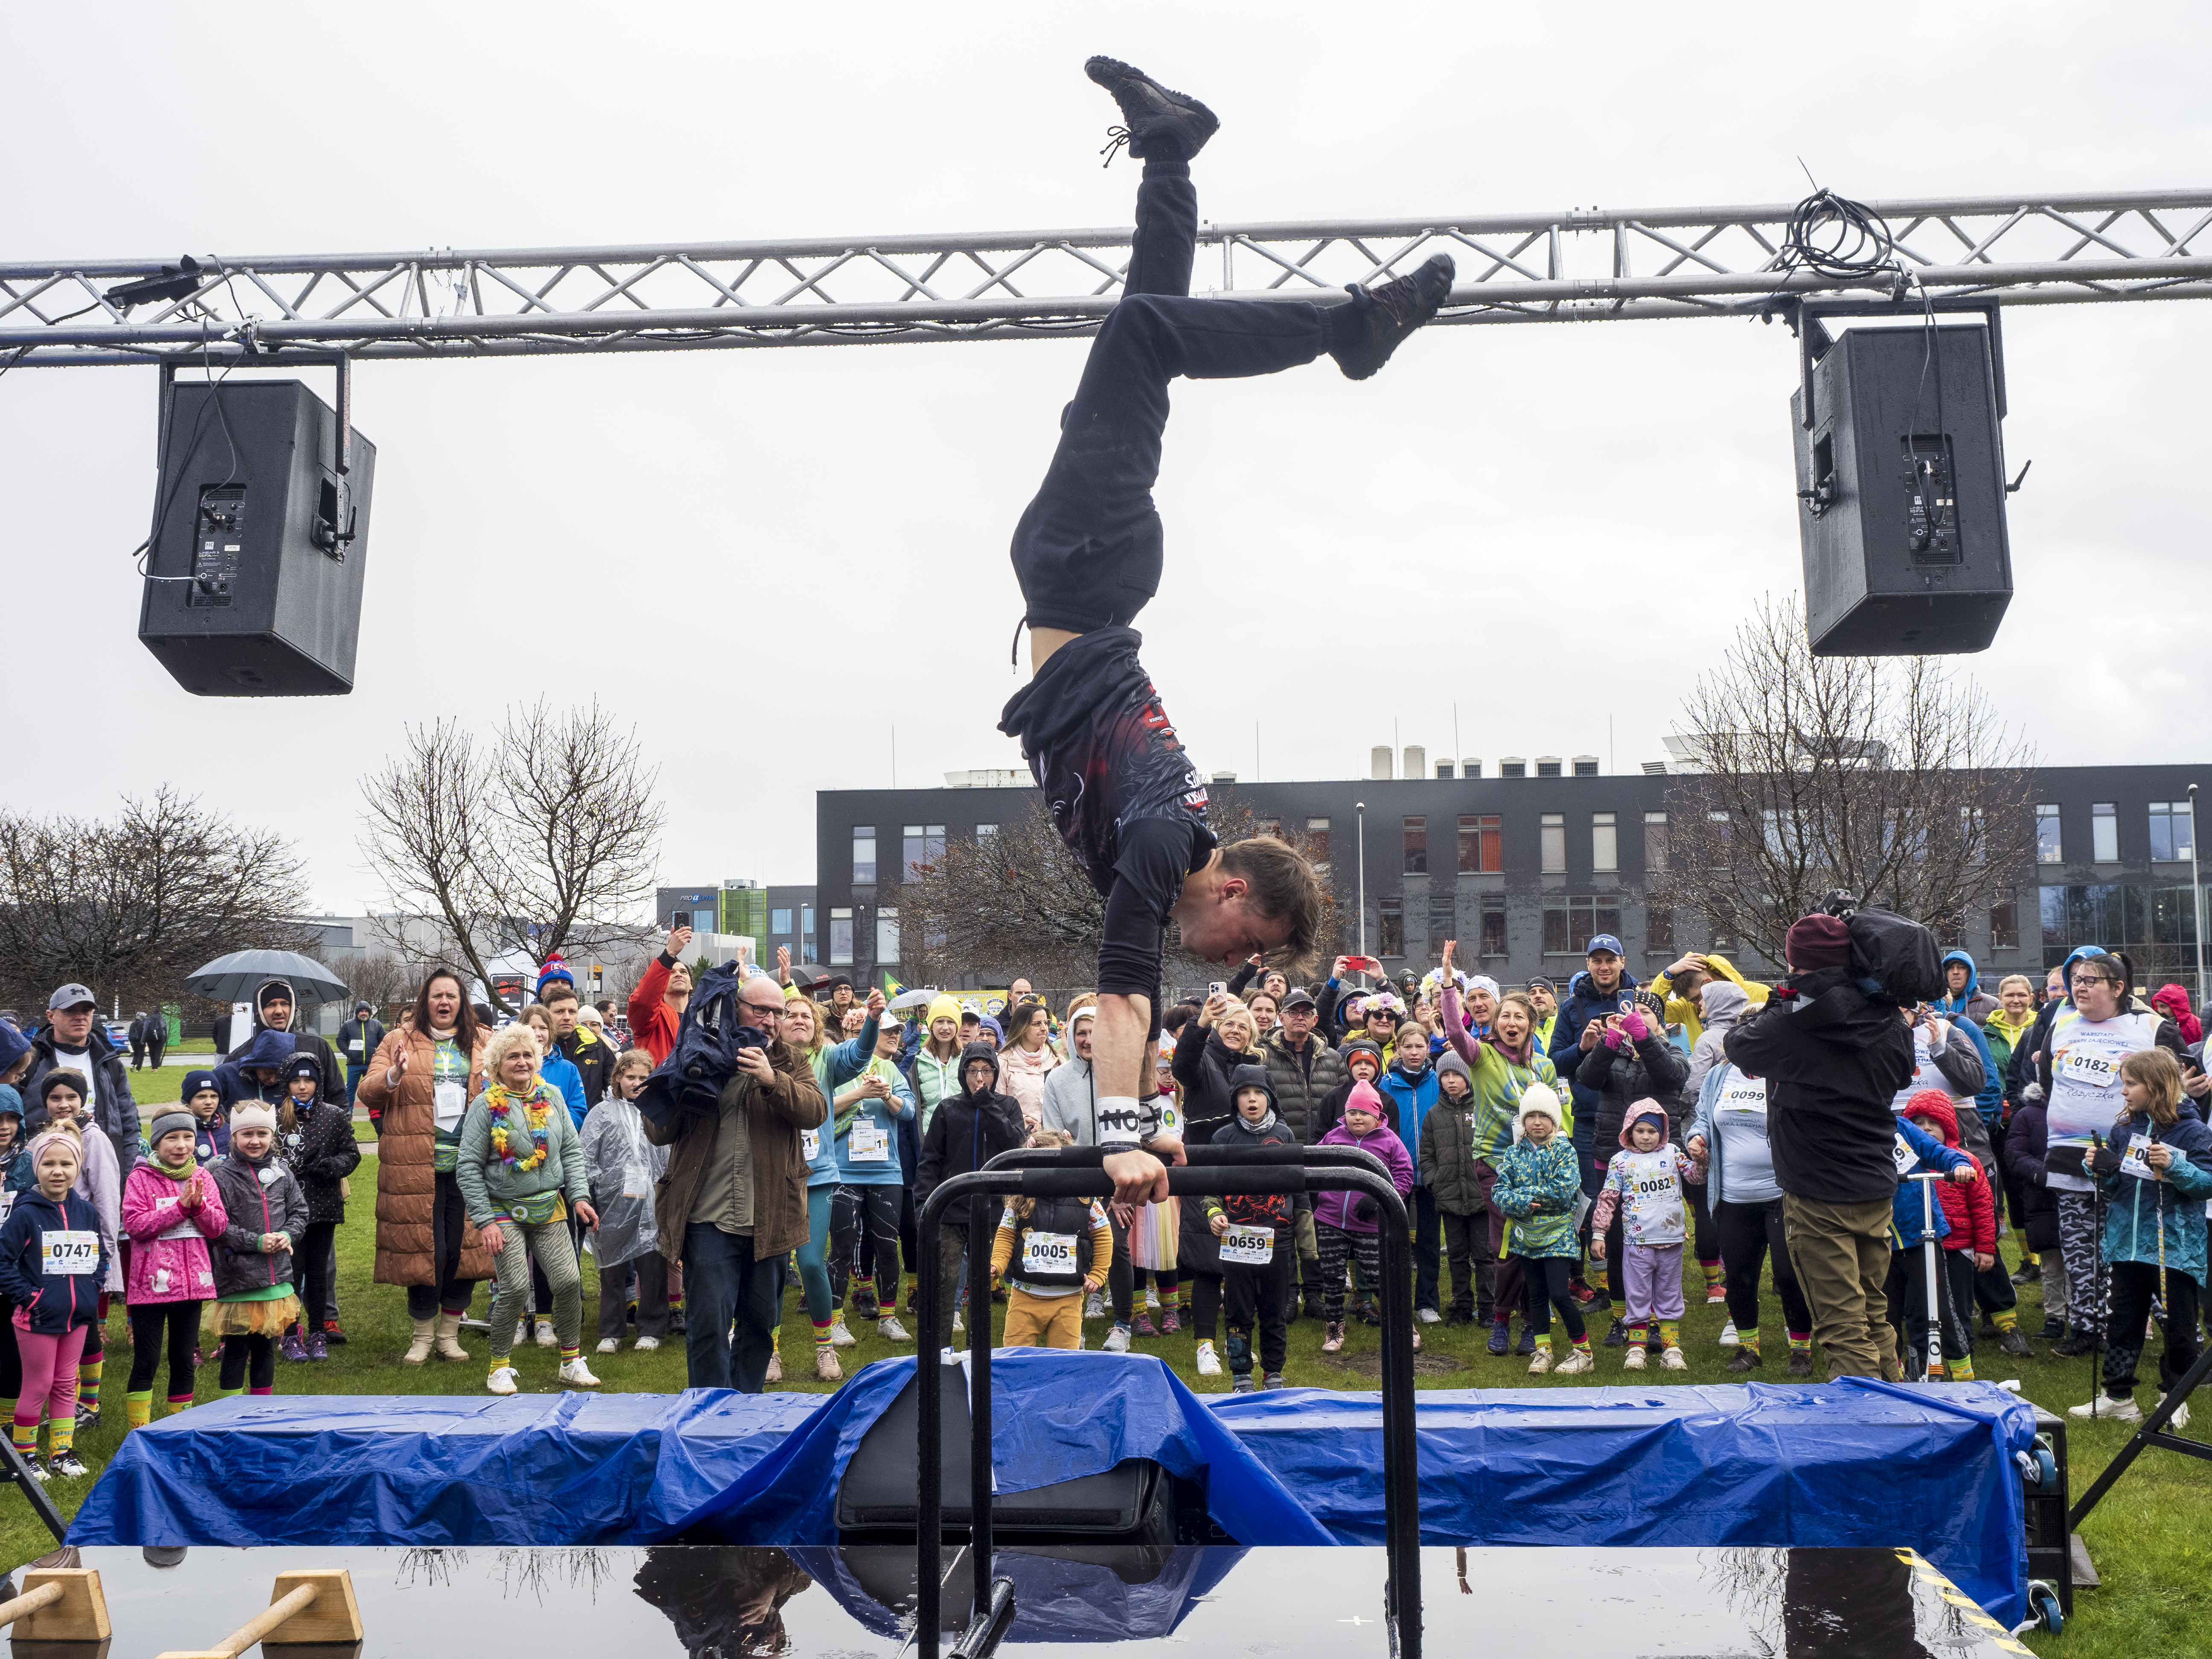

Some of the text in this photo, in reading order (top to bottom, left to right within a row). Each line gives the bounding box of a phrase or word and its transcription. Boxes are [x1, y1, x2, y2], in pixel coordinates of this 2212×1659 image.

[2088, 1039, 2128, 1047] ZAJĘCIOWEJ
[2074, 1057, 2109, 1073] 0182
[1731, 1091, 1765, 1100] 0099
[1640, 1177, 1671, 1193] 0082
[1229, 1235, 1266, 1250] 0659
[53, 1244, 91, 1257] 0747
[1031, 1244, 1068, 1259] 0005
